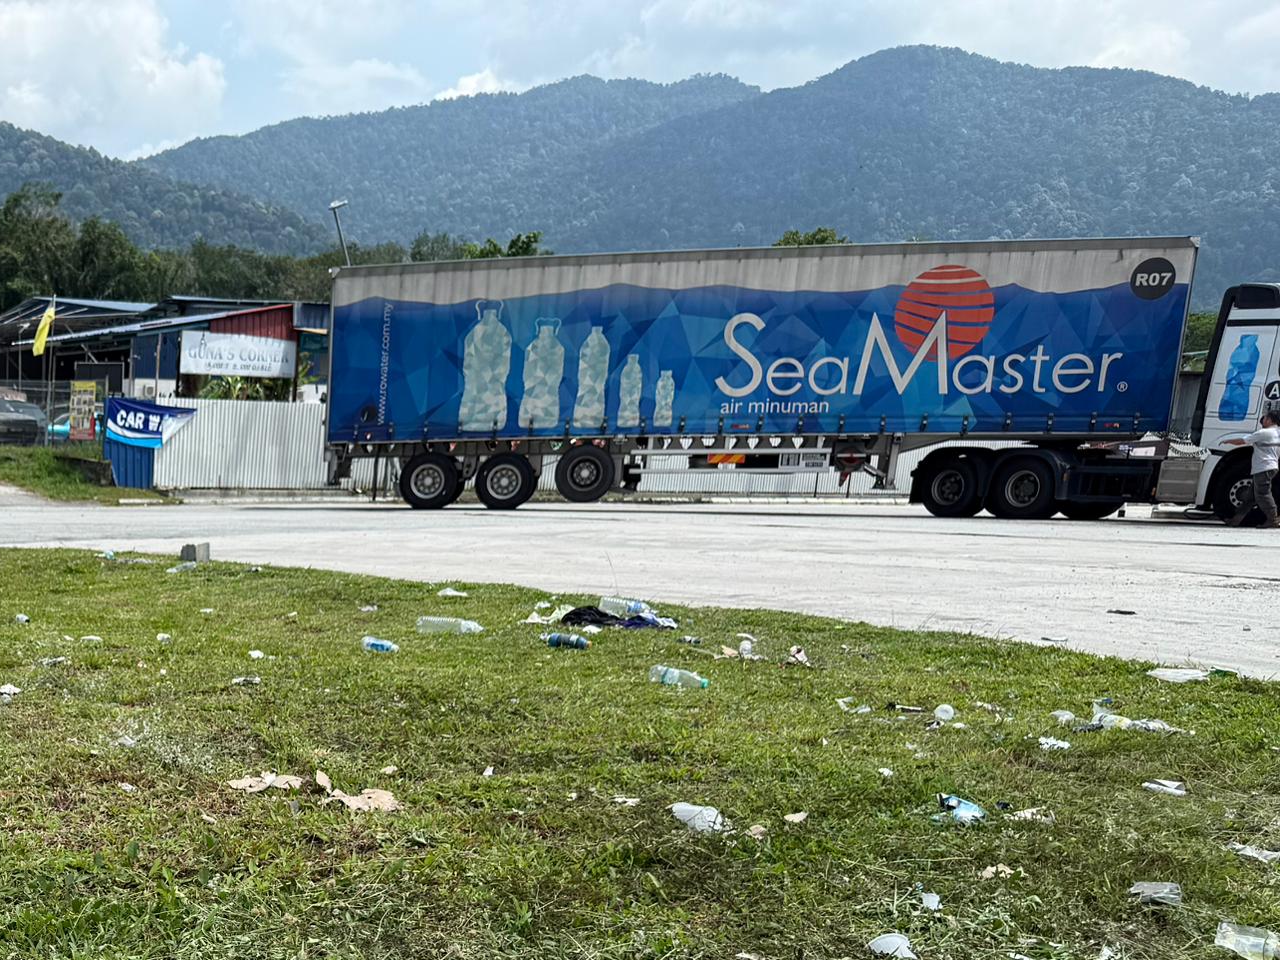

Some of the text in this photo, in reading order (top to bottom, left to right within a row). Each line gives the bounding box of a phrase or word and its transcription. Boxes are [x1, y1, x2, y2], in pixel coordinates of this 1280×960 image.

[1135, 272, 1172, 287] R07
[378, 302, 394, 425] www.rowater.com.my
[720, 398, 829, 414] air minuman
[116, 409, 145, 430] CAR
